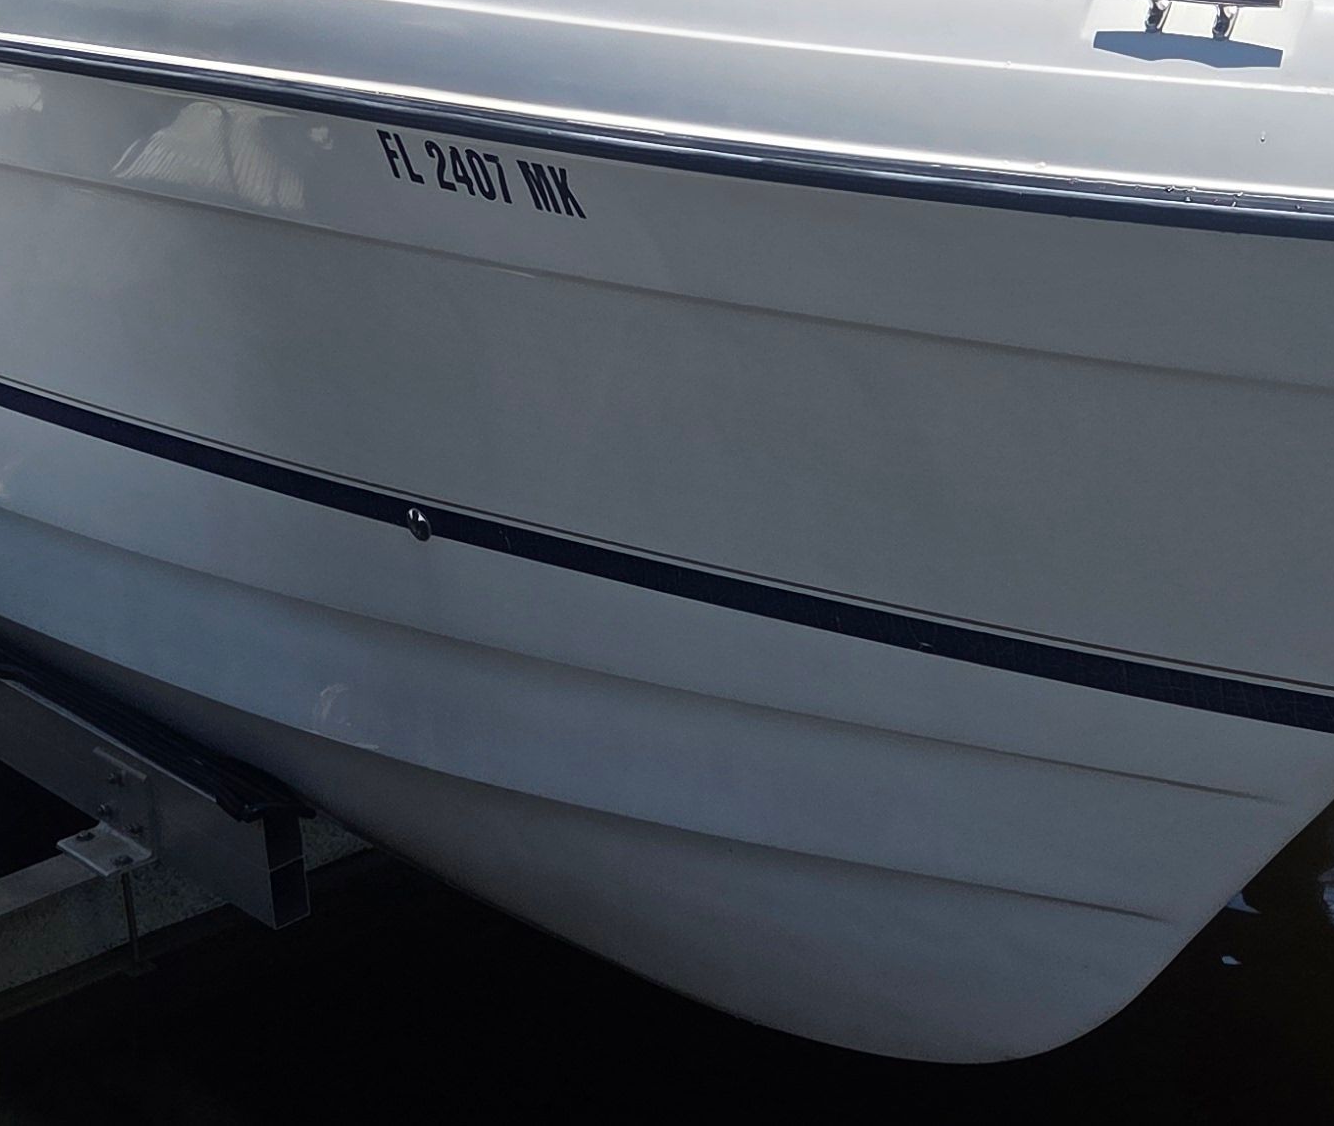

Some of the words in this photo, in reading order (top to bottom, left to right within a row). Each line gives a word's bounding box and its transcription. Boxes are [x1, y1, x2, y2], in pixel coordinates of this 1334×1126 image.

[376, 129, 425, 184] FL
[424, 140, 513, 204] 2407
[516, 159, 587, 219] MK
